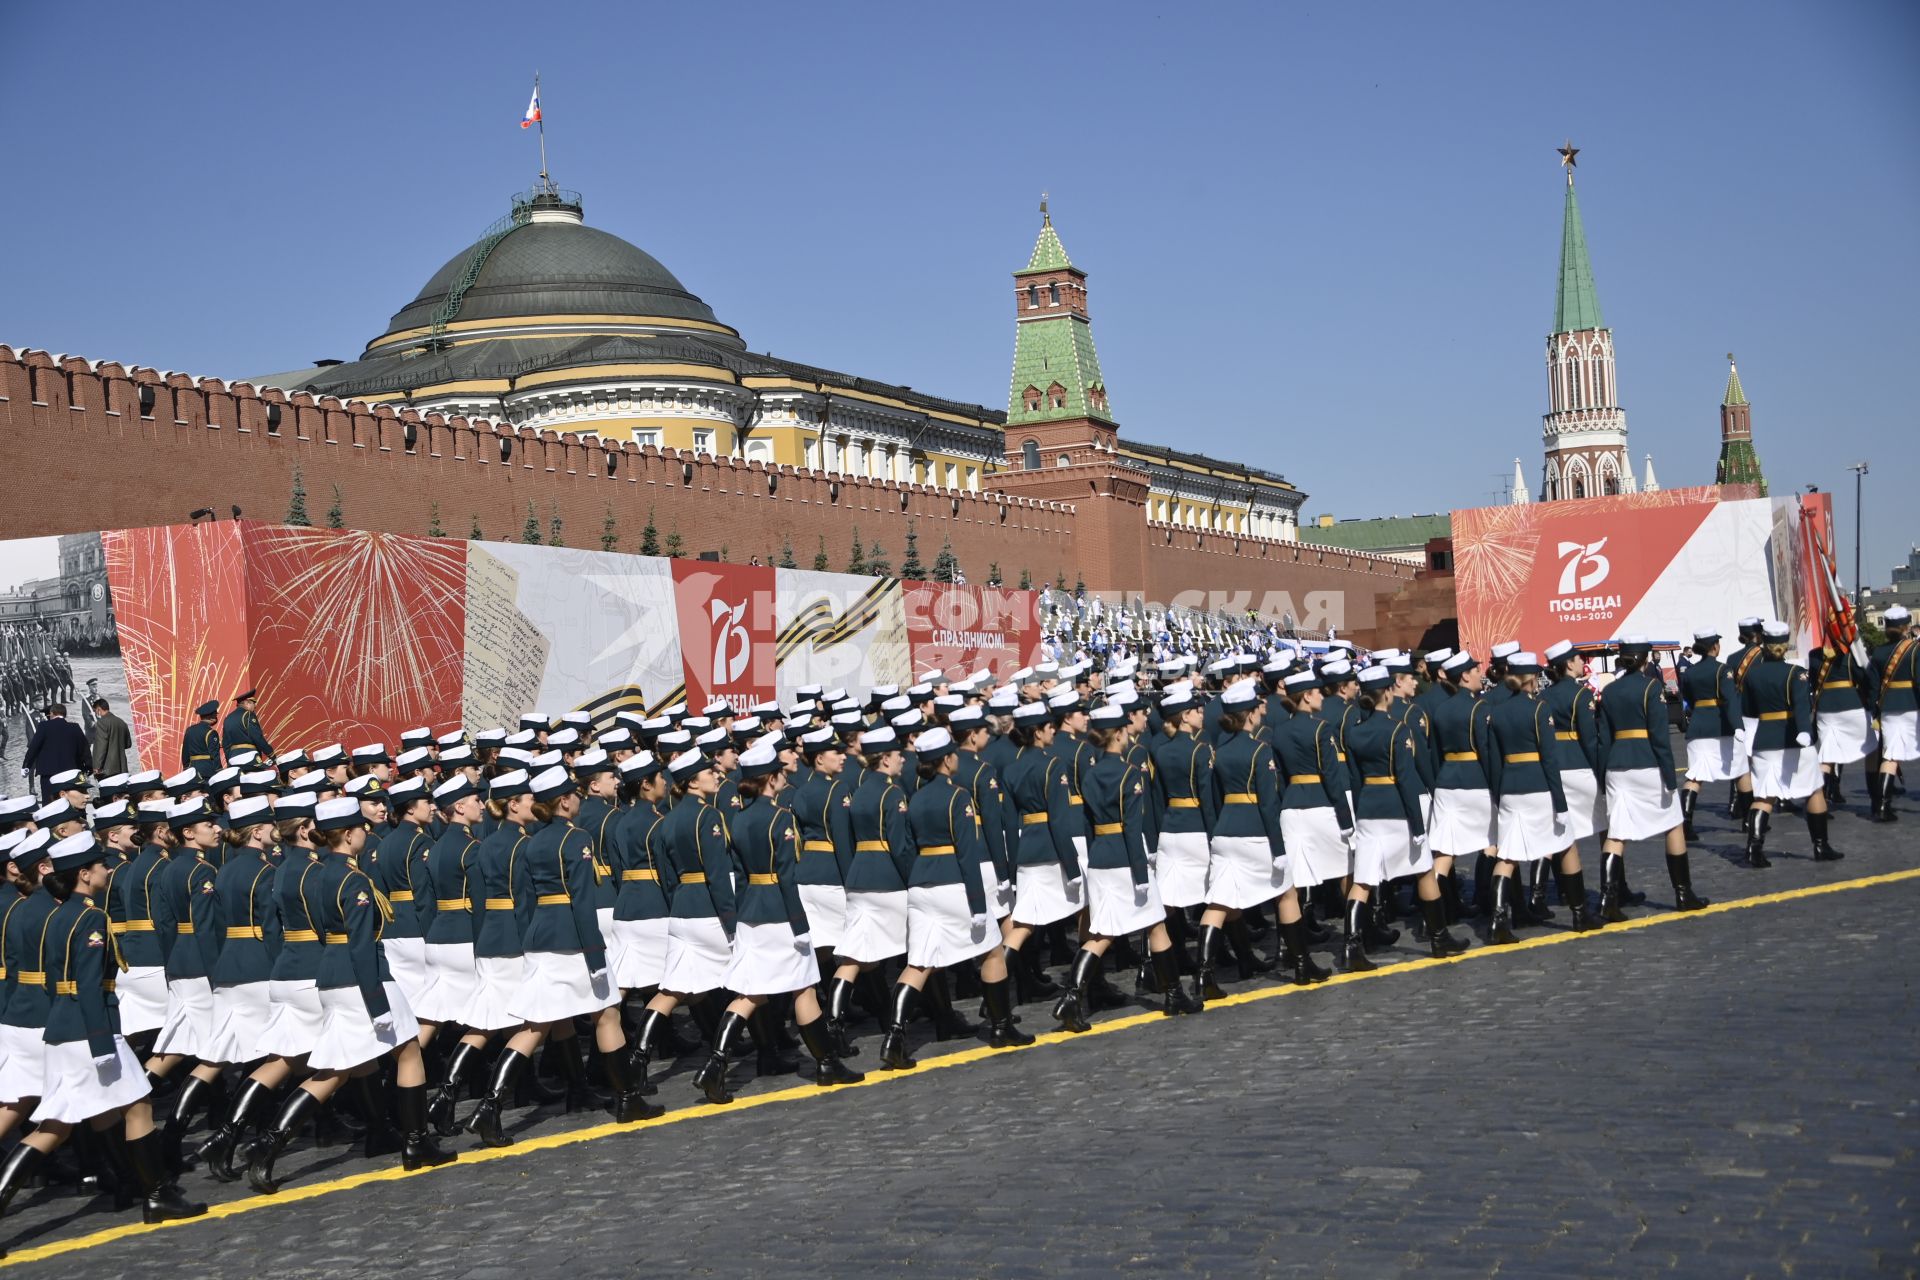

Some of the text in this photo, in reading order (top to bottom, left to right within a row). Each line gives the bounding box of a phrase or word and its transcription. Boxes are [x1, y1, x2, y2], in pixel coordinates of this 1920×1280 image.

[1557, 536, 1610, 595] 75
[1549, 595, 1622, 613] ПОБЕДА!
[711, 598, 750, 685] 75
[932, 630, 1005, 651] С ПРАЗДНИКОМ!
